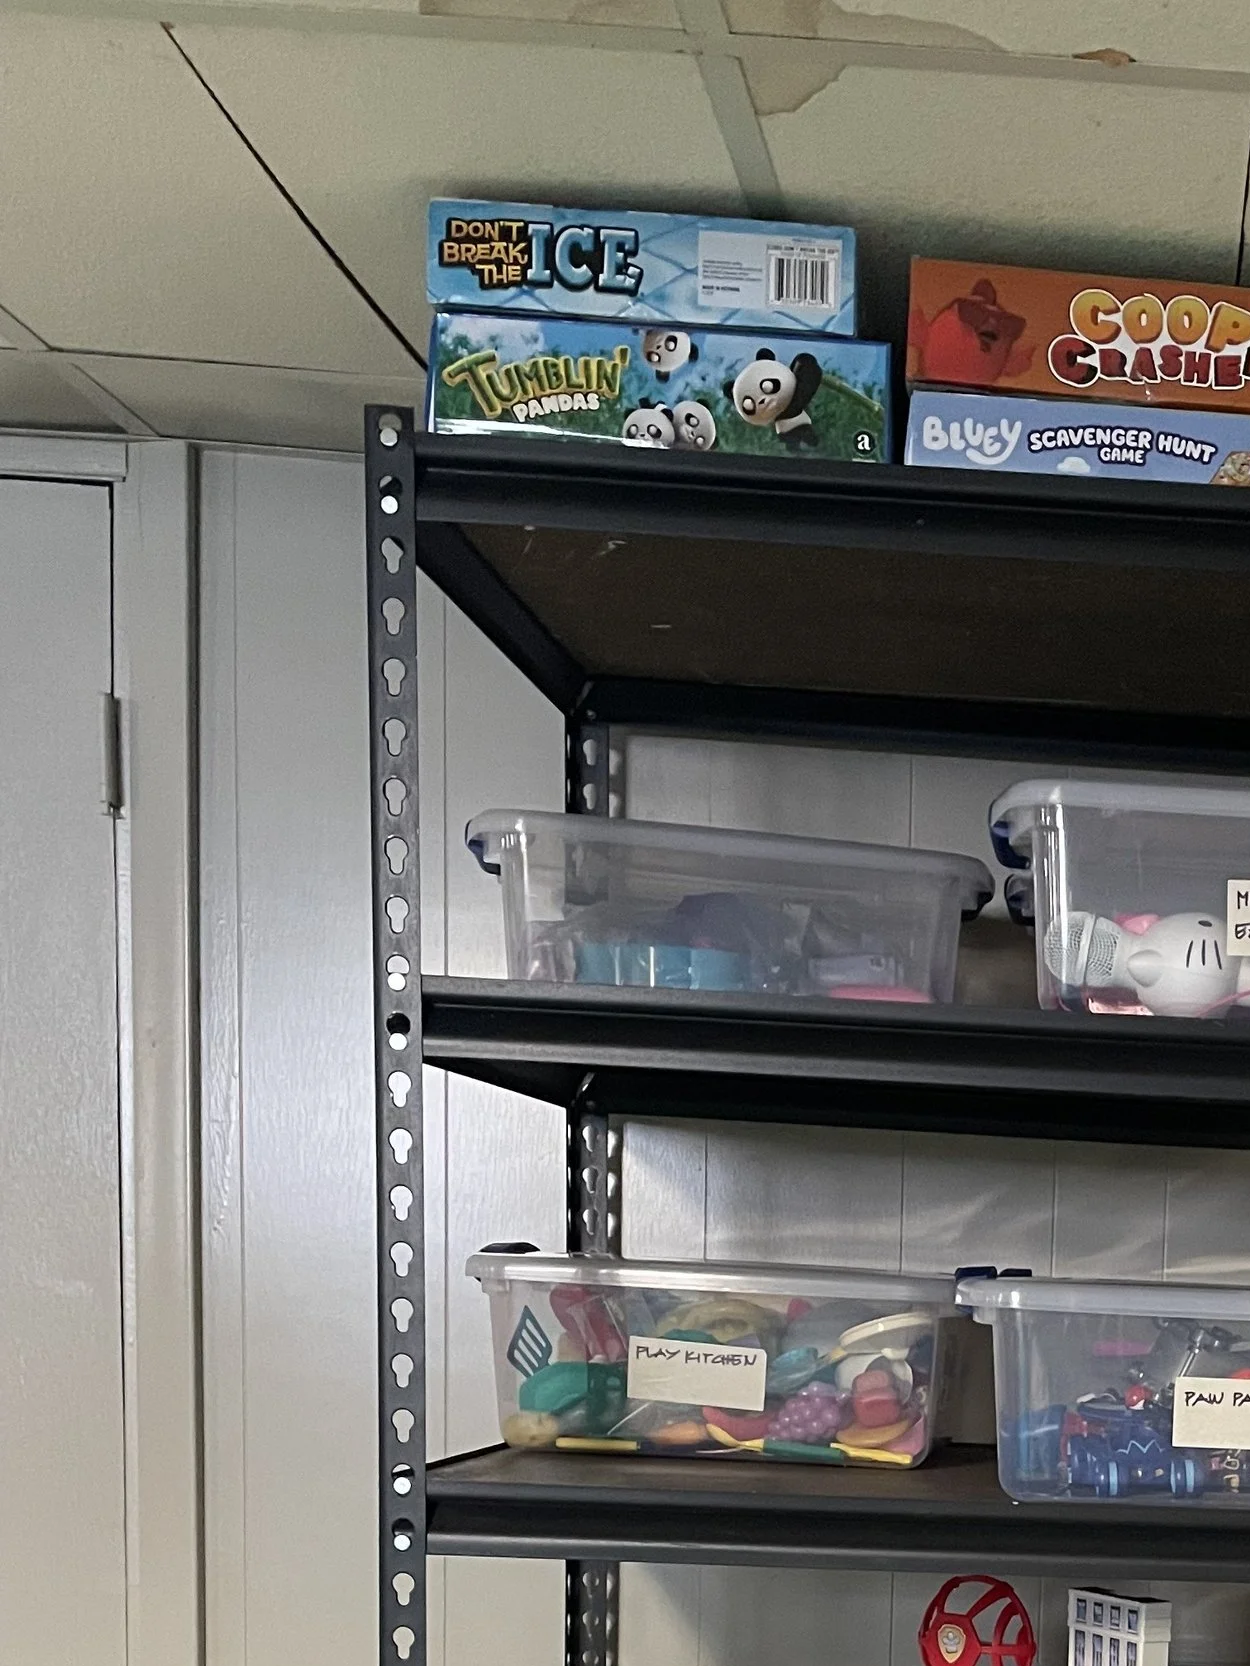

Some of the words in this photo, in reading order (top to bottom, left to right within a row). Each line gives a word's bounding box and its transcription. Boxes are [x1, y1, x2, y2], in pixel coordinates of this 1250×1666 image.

[451, 220, 524, 241] DON'T
[443, 242, 529, 264] BREAK
[527, 223, 640, 290] ICE
[475, 265, 521, 284] THE
[442, 346, 631, 418] TUMBLIN'
[512, 394, 600, 422] PANDAS
[1030, 426, 1151, 452] SCAVENGER
[1158, 435, 1216, 464] HUNT
[1100, 448, 1144, 464] GAME
[636, 1345, 681, 1361] PLAY
[684, 1350, 758, 1367] KITCHEN
[1184, 1391, 1224, 1406] PAW
